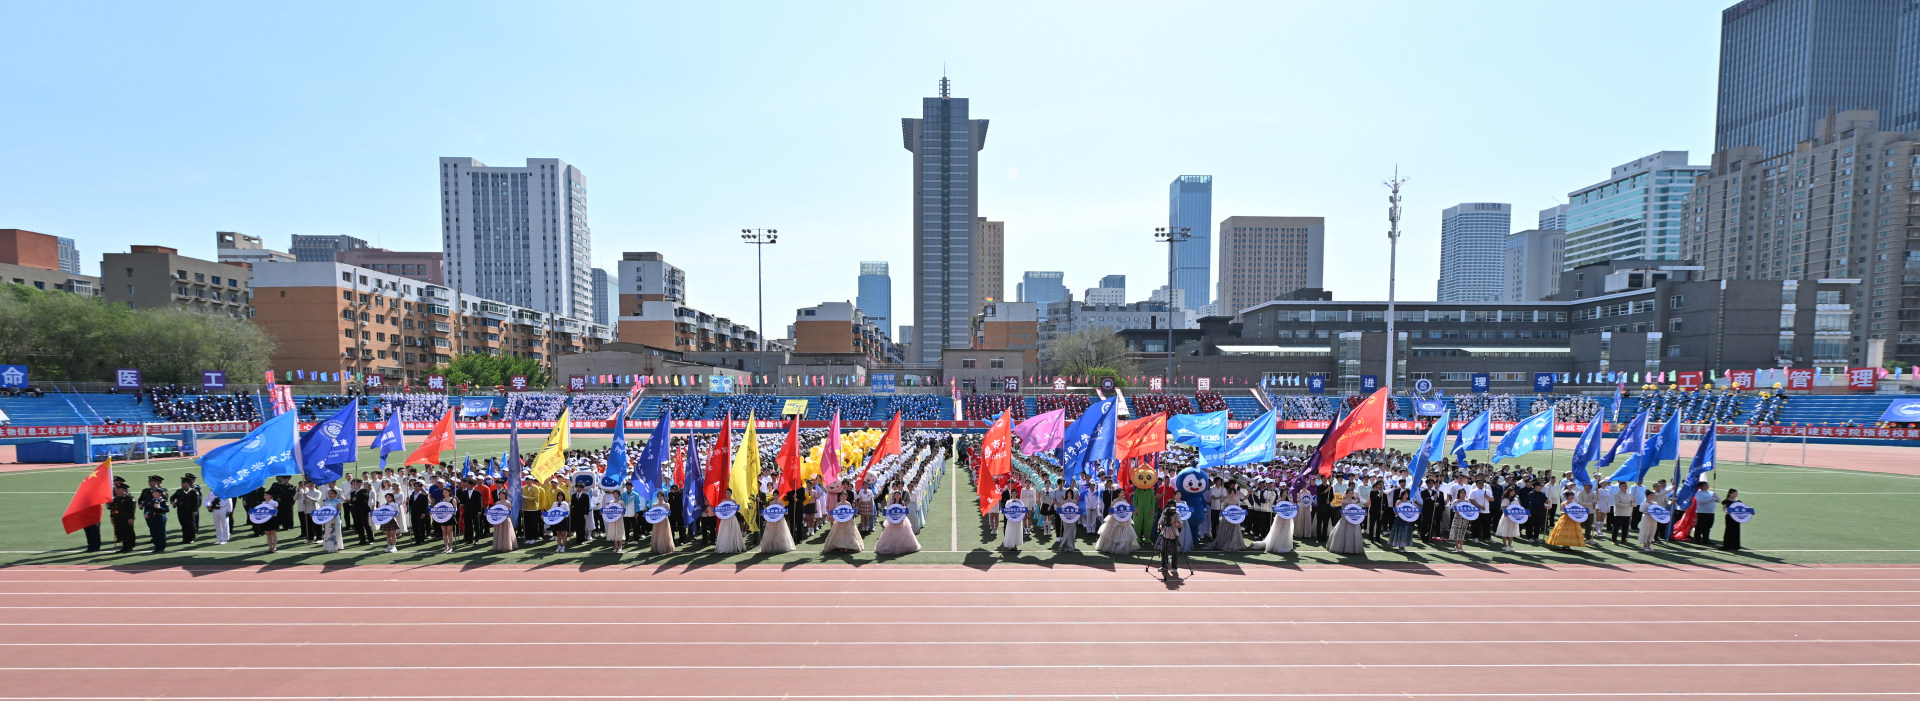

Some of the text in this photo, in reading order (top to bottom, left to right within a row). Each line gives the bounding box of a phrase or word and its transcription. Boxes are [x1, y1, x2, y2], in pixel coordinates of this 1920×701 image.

[2, 367, 24, 386] 命
[118, 370, 223, 386] 医 工
[367, 376, 584, 389] 机 械 学 院
[1475, 376, 1550, 386] 理 学
[1680, 370, 1874, 388] 工 商 管 理
[1006, 378, 1210, 390] 冶 金 报 国
[1313, 378, 1375, 389] 奋 进
